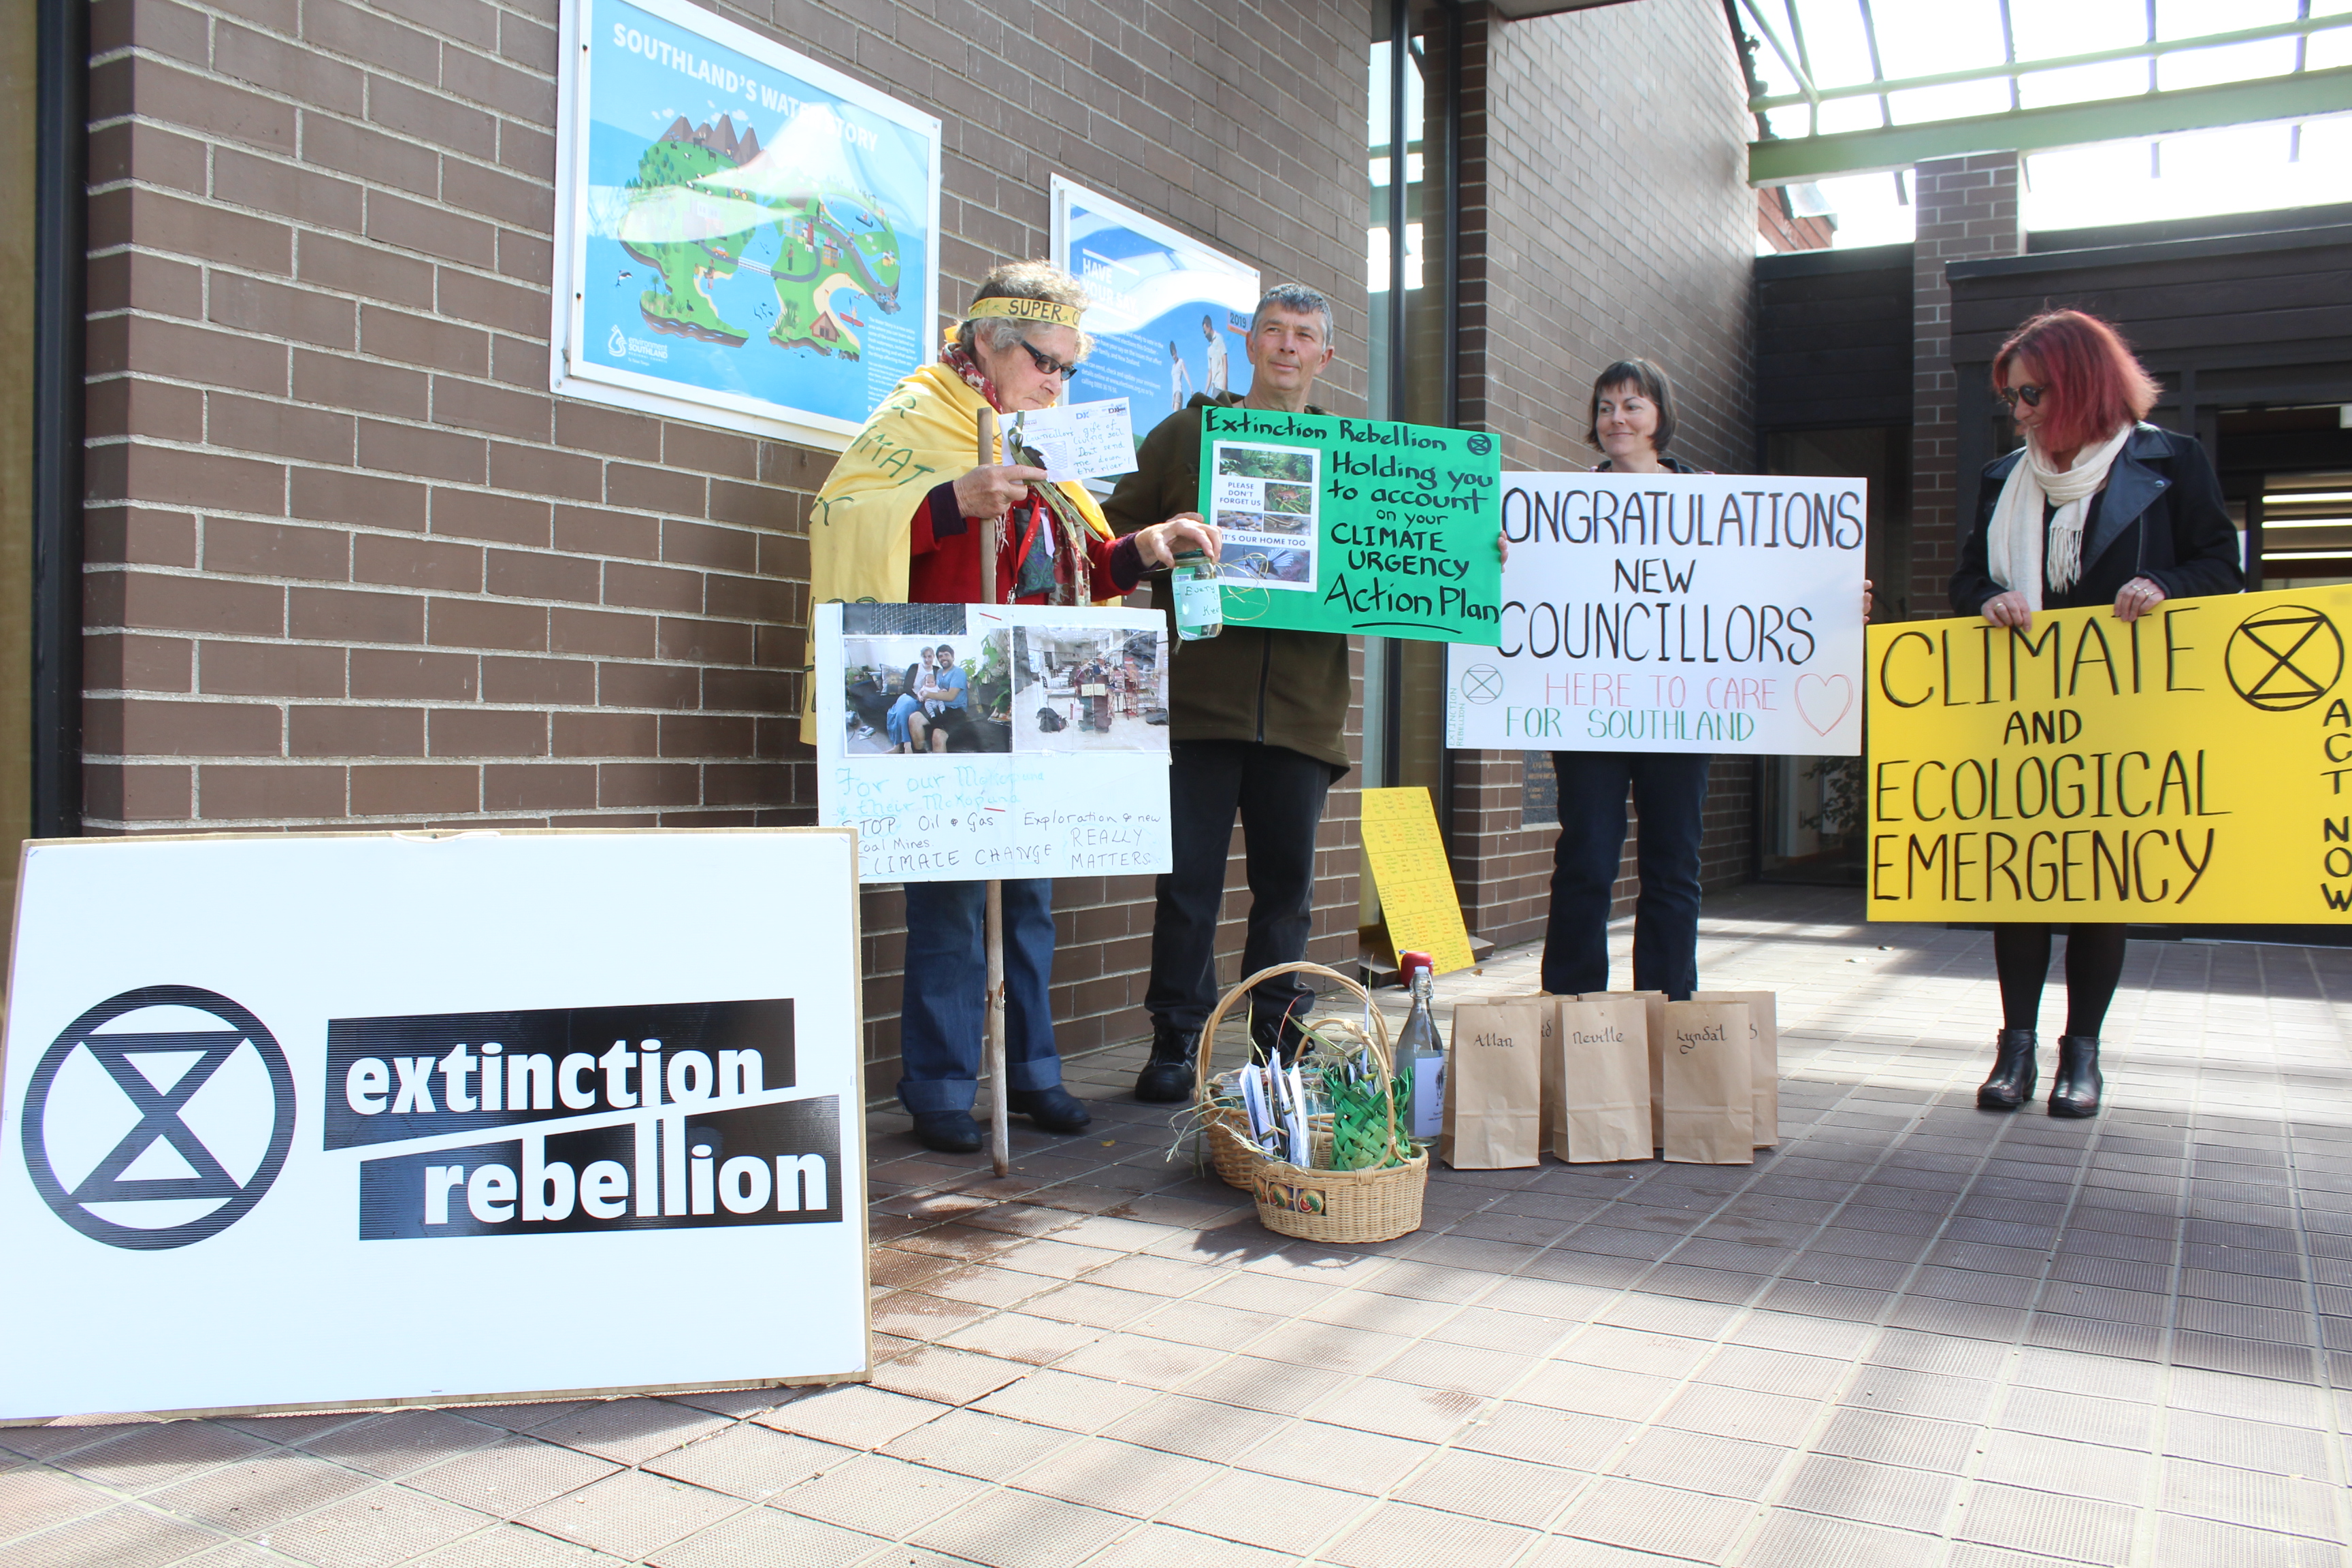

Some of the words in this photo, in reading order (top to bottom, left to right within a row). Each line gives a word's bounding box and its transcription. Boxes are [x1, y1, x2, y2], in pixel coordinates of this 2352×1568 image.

[612, 22, 757, 102] SOUTHLAND'S
[825, 114, 878, 152] STORY
[1082, 257, 1113, 284] HAVE
[1082, 279, 1115, 306] YOUR
[1008, 299, 1062, 322] SUPER
[1230, 311, 1247, 329] 2019
[628, 338, 668, 351] environment
[628, 343, 668, 359] SOUTHLAND
[1083, 422, 1100, 438] gift
[1106, 419, 1117, 431] of
[1205, 406, 1327, 440] Extinction
[1340, 419, 1447, 451] Rebellion
[1098, 455, 1121, 463] down
[1104, 441, 1125, 451] send
[1077, 466, 1096, 475] the
[1333, 451, 1435, 489] Holding
[1448, 470, 1492, 492] you
[1220, 497, 1249, 505] FORGET
[1327, 478, 1358, 500] to
[1371, 489, 1488, 514] account
[1377, 508, 1396, 521] on
[1405, 512, 1448, 528] your
[1501, 487, 1864, 549] ONGRATULATIONS
[1331, 523, 1447, 553] CLIMATE
[1185, 586, 1215, 596] Every
[1614, 558, 1696, 594] NEW
[1324, 573, 1433, 617] Action
[1439, 585, 1499, 624] Plan
[1497, 600, 1815, 664] COUNCILLORS
[1880, 606, 2205, 708] CLIMATE
[1546, 672, 1633, 708] HERE
[1648, 675, 1686, 708] TO
[1708, 676, 1778, 710] CARE
[1448, 687, 1457, 746] EXTINCTION
[1456, 703, 1465, 747] REBELLION
[1506, 706, 1563, 738] FOR
[1588, 708, 1754, 742] SOUTHLAND
[2003, 709, 2082, 746] AND
[836, 768, 889, 797] For
[907, 774, 945, 792] our
[1876, 749, 2233, 822] ECOLOGICAL
[858, 798, 915, 814] their
[919, 815, 939, 831] Oil
[967, 812, 994, 832] Gas
[1024, 809, 1117, 826] Exploration
[1138, 814, 1161, 823] new
[1070, 827, 1143, 847] REALLY
[975, 844, 1052, 866] CHANGE
[1874, 828, 2215, 904] EMERGENCY
[1473, 1032, 1514, 1048] Allan
[1676, 1024, 1728, 1055] Lyndal
[346, 1038, 765, 1115] extinction
[425, 1116, 828, 1225] rebellion
